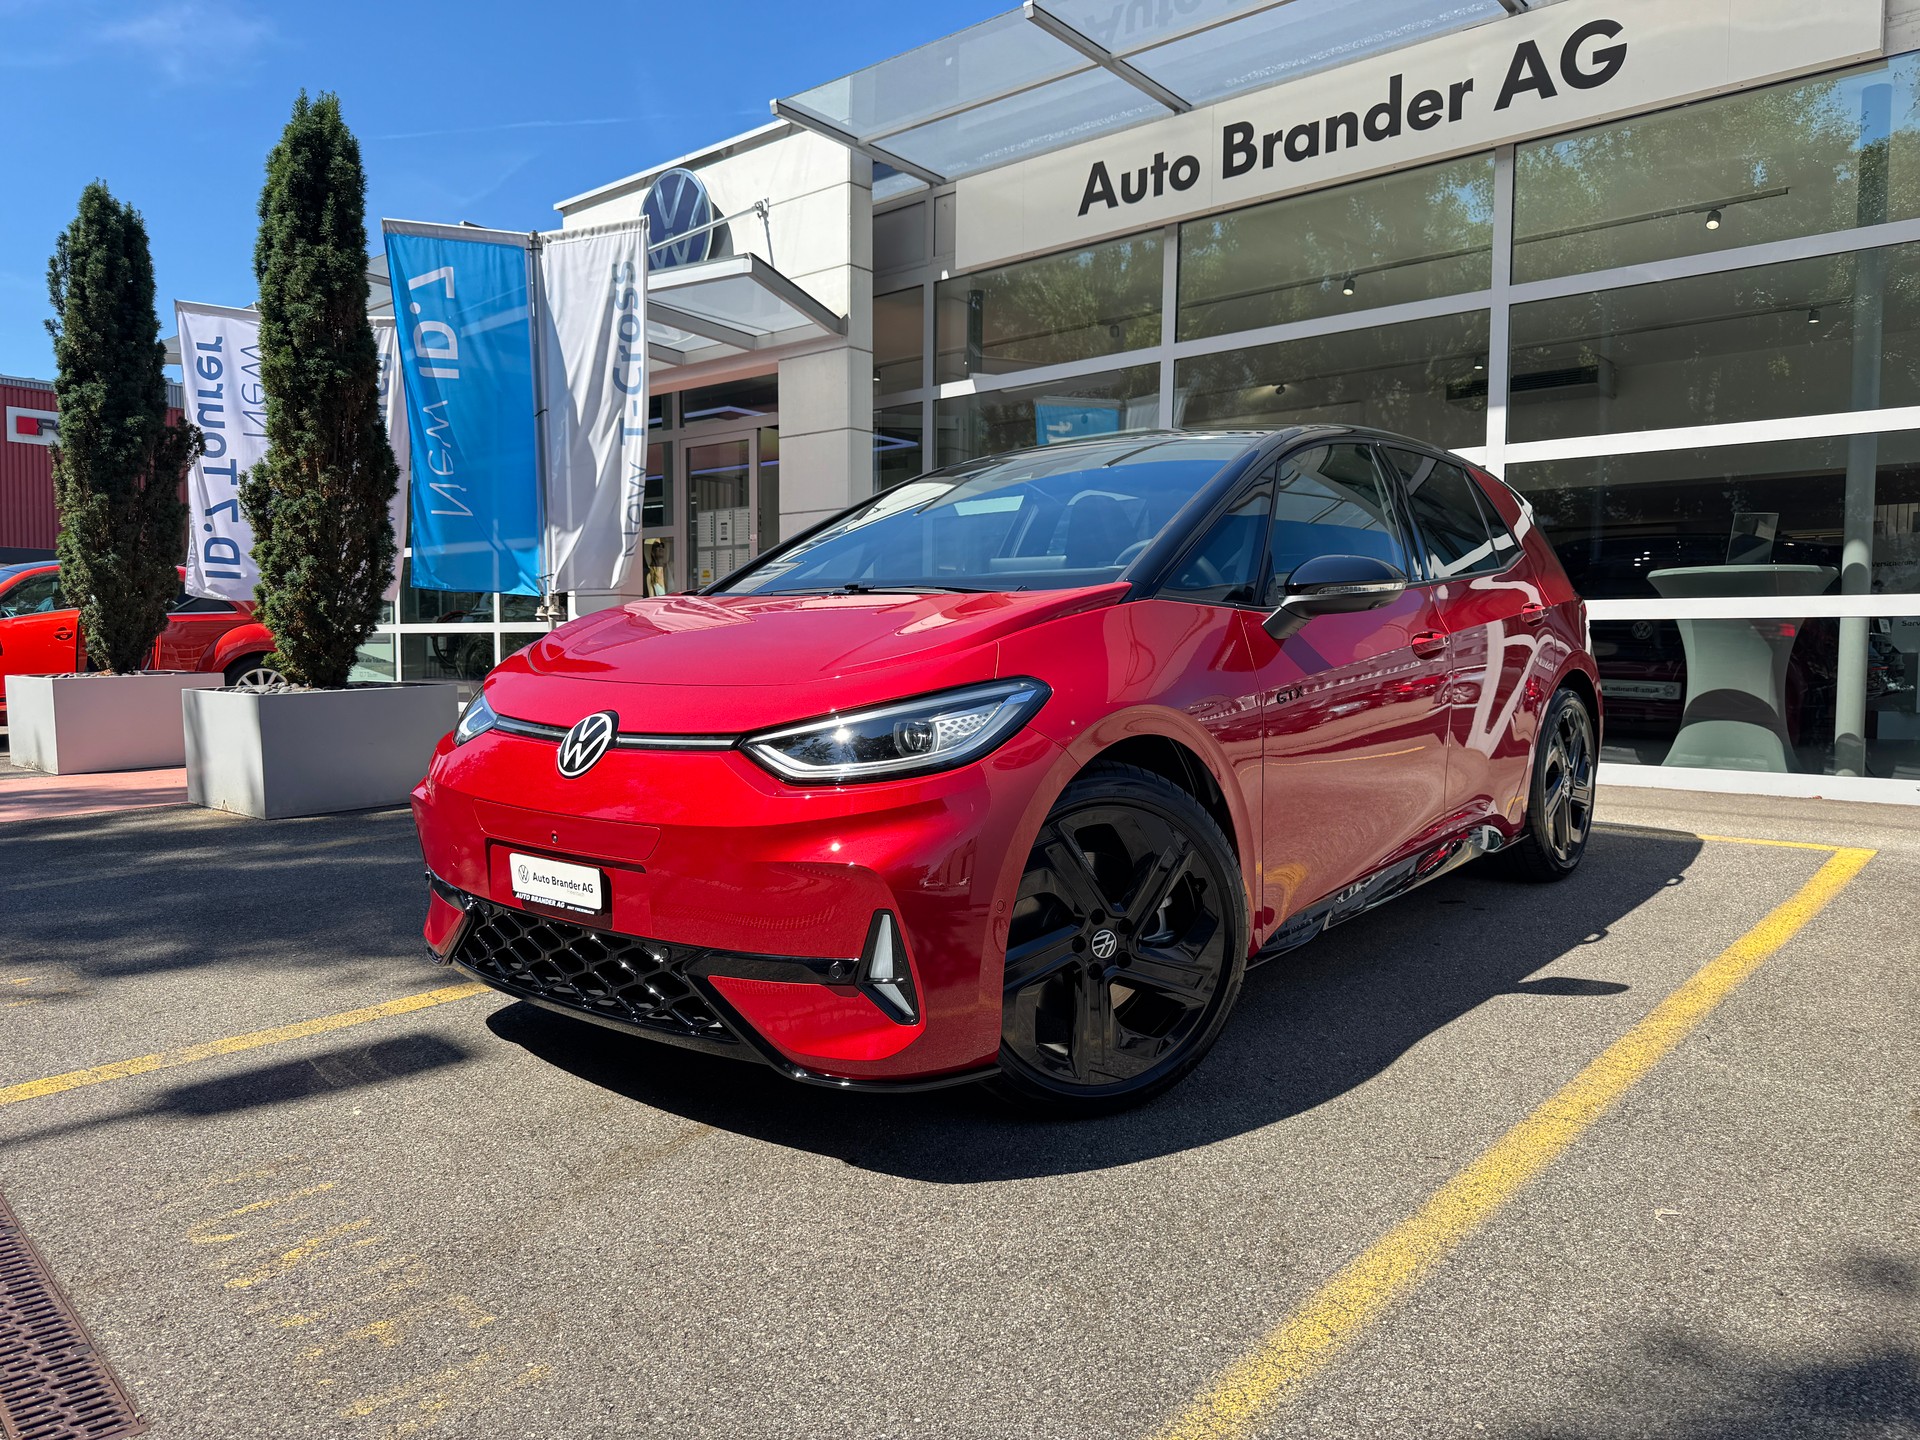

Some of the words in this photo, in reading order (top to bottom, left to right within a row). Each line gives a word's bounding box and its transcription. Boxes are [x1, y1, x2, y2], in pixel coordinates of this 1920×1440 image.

[1078, 152, 1199, 217] Auto
[1222, 74, 1474, 180] Brander
[1494, 19, 1628, 111] AG
[612, 259, 647, 447] T-Cross
[1277, 686, 1304, 705] GTX
[532, 871, 550, 884] Auto
[551, 876, 581, 891] Brander
[582, 883, 594, 894] AG
[515, 892, 531, 901] AUTO
[531, 895, 557, 907] BRANDER
[557, 901, 566, 909] AG
